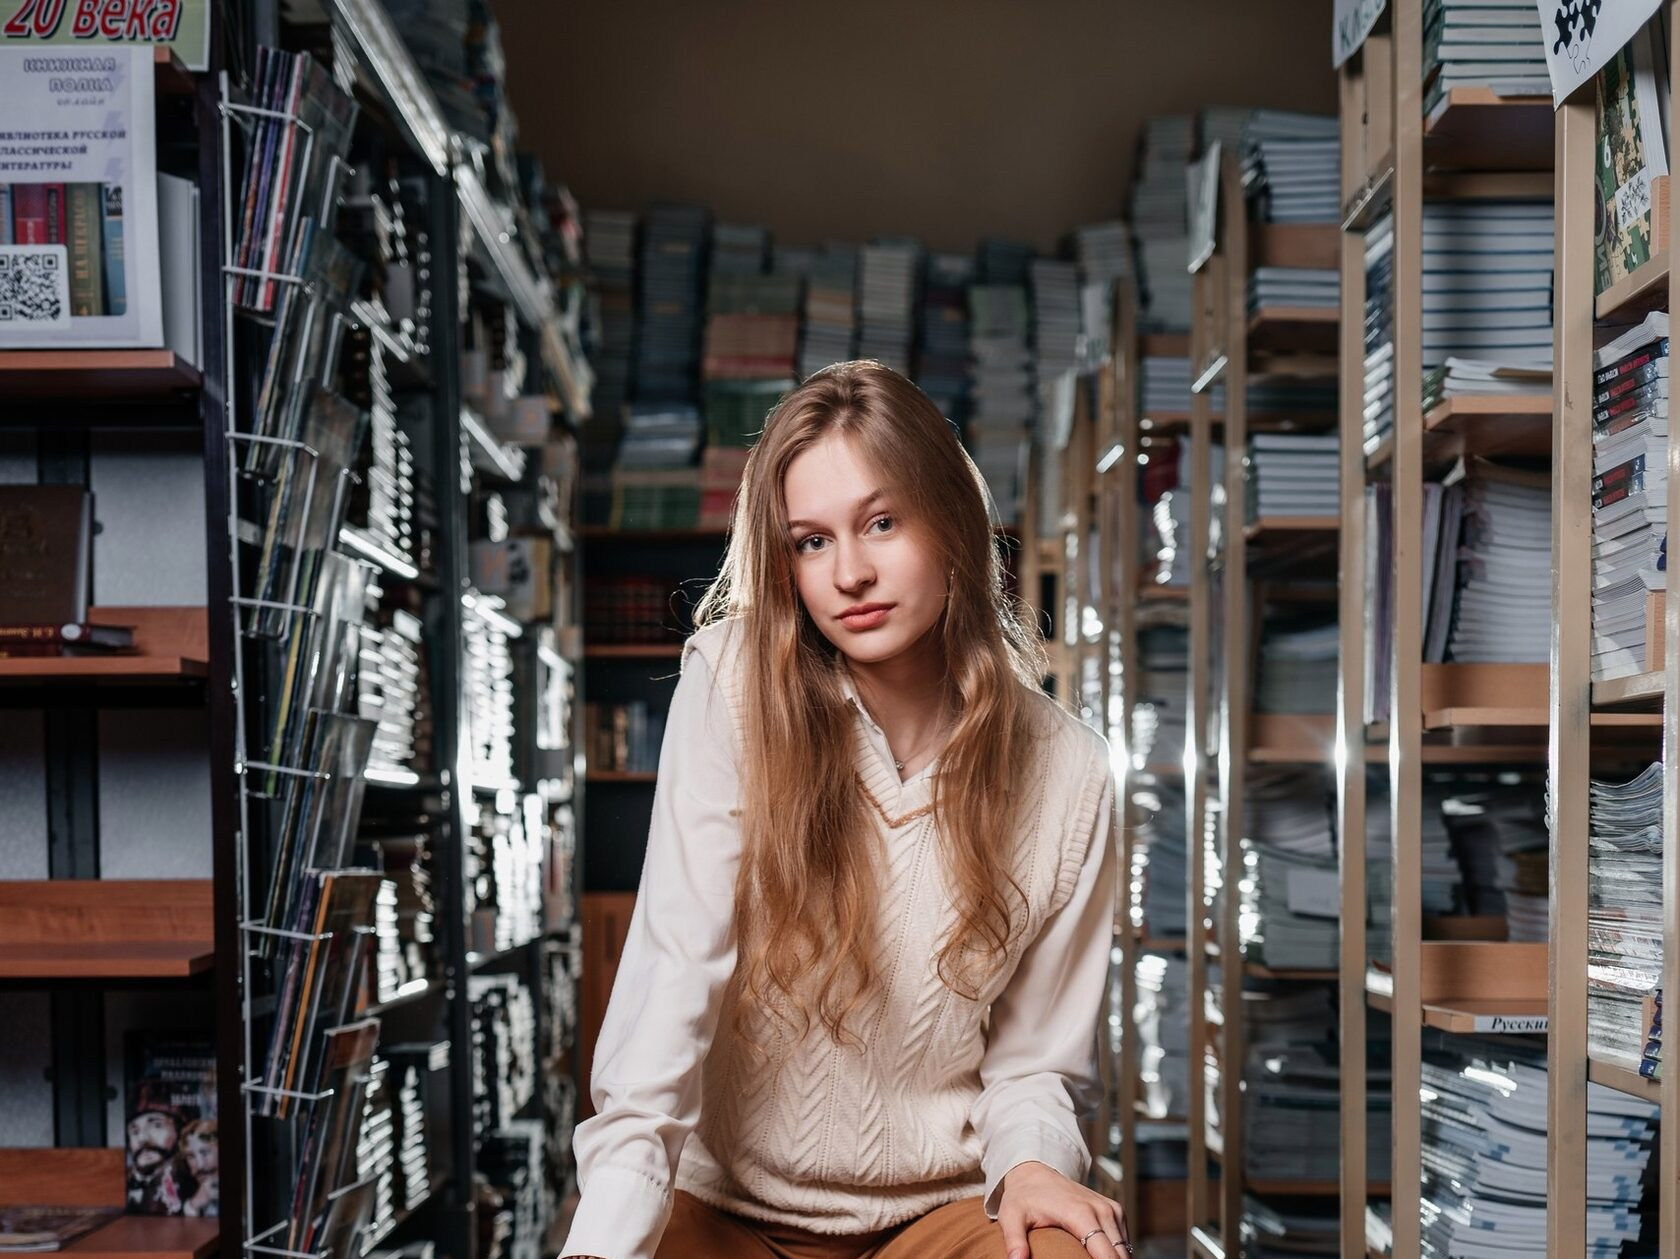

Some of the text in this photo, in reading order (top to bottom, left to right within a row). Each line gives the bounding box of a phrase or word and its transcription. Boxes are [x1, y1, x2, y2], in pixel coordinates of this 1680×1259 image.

[3, 0, 180, 40] 20 века
[24, 58, 116, 72] КНИЖНАЯ
[73, 130, 126, 139] РУССКОЙ
